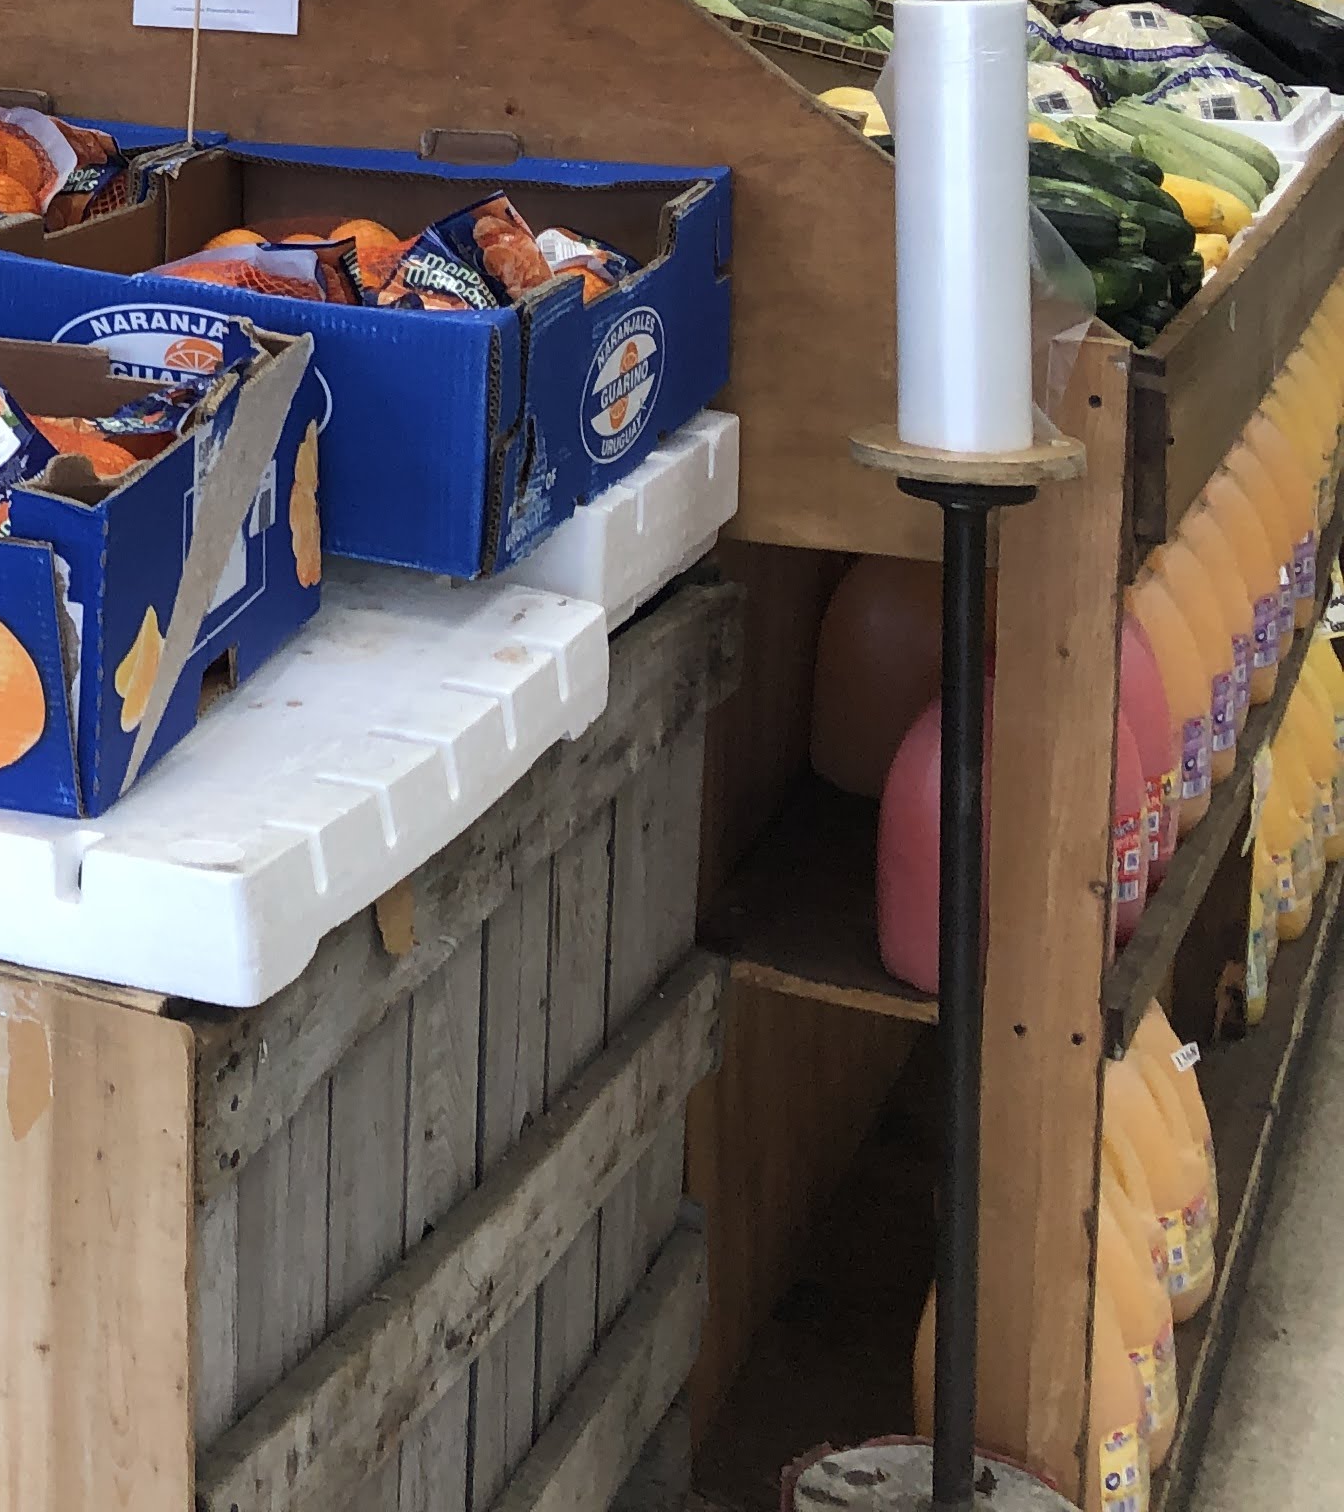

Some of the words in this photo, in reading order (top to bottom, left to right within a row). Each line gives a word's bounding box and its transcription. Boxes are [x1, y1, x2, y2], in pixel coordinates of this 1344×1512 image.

[597, 313, 656, 371] NARANJALES
[600, 359, 649, 409] GUARINO
[600, 411, 645, 457] URUGUAY
